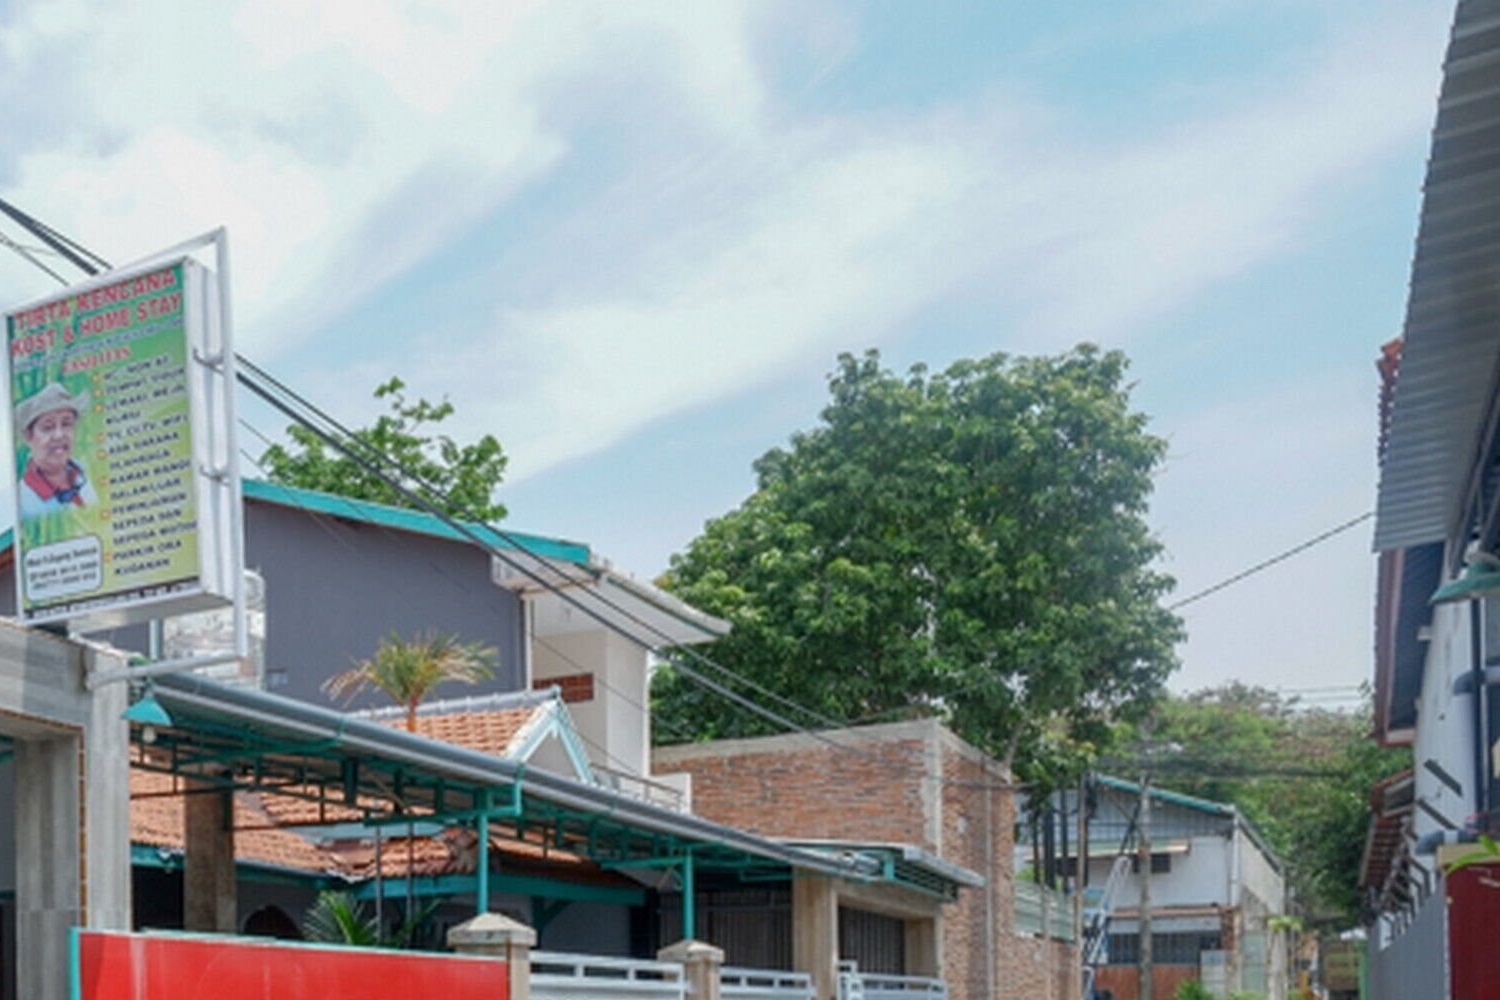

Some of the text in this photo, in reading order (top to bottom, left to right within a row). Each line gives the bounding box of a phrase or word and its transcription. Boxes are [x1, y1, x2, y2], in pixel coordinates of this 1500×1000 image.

[15, 268, 174, 328] TIRTA KENCANA
[80, 309, 129, 337] HOME
[136, 293, 181, 321] STAY
